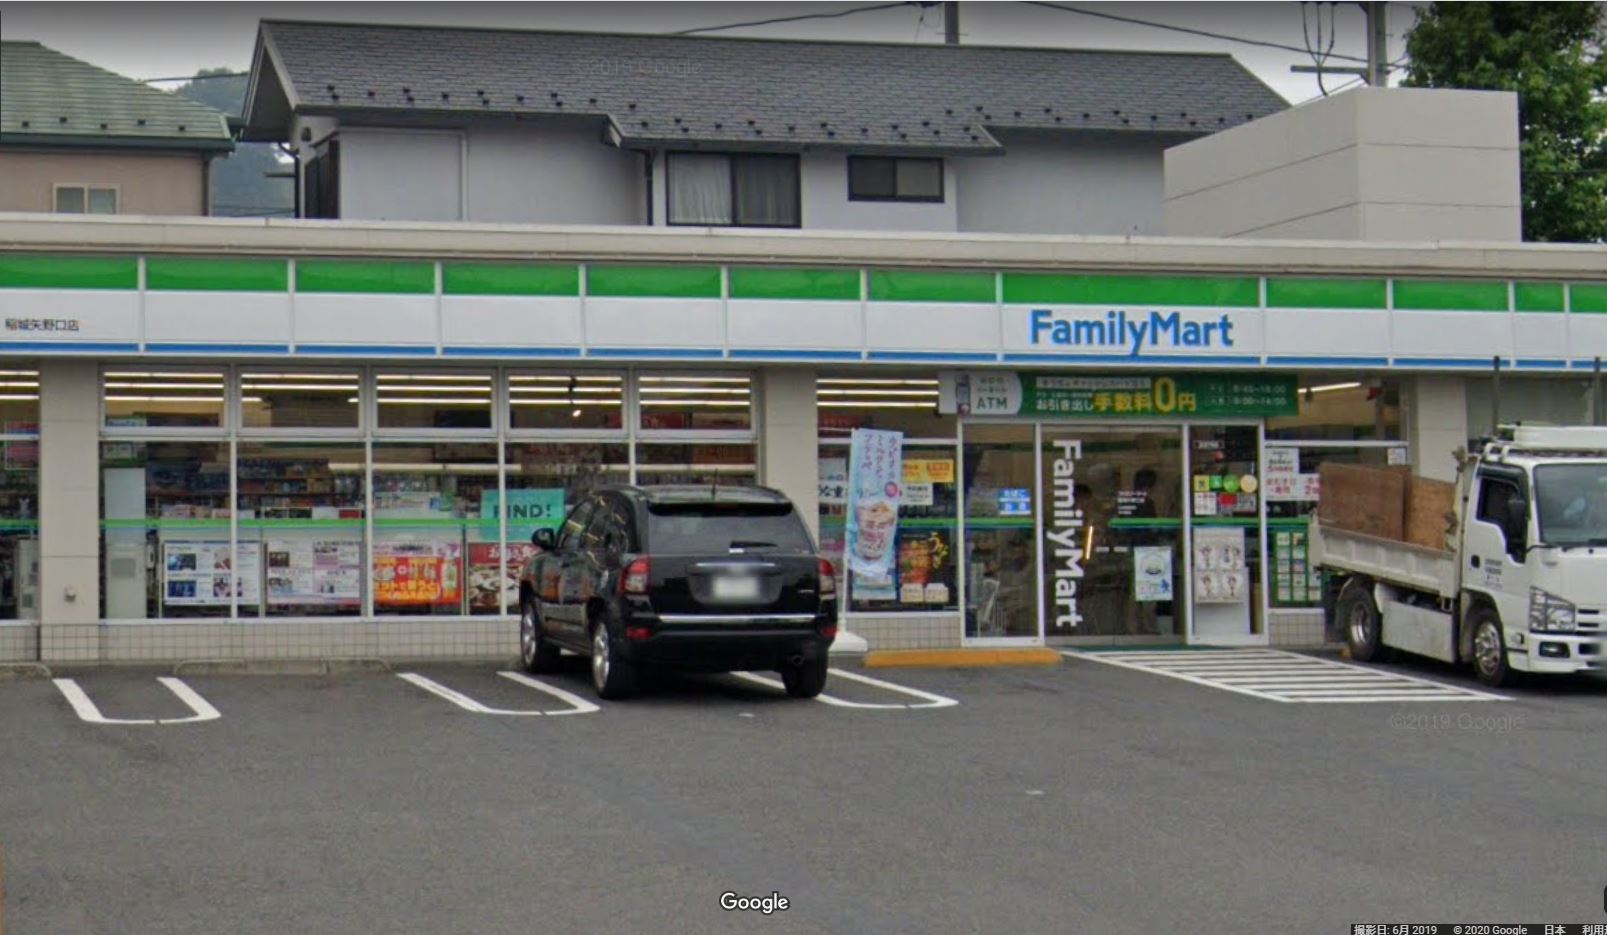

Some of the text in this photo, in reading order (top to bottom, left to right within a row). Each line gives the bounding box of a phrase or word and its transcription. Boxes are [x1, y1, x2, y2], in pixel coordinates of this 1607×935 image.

[5, 318, 80, 331] 稲城矢野口店
[1029, 309, 1234, 356] FamilyMart
[976, 397, 1008, 410] ATM
[493, 504, 551, 518] FIND!
[1046, 440, 1084, 627] FamilyMart
